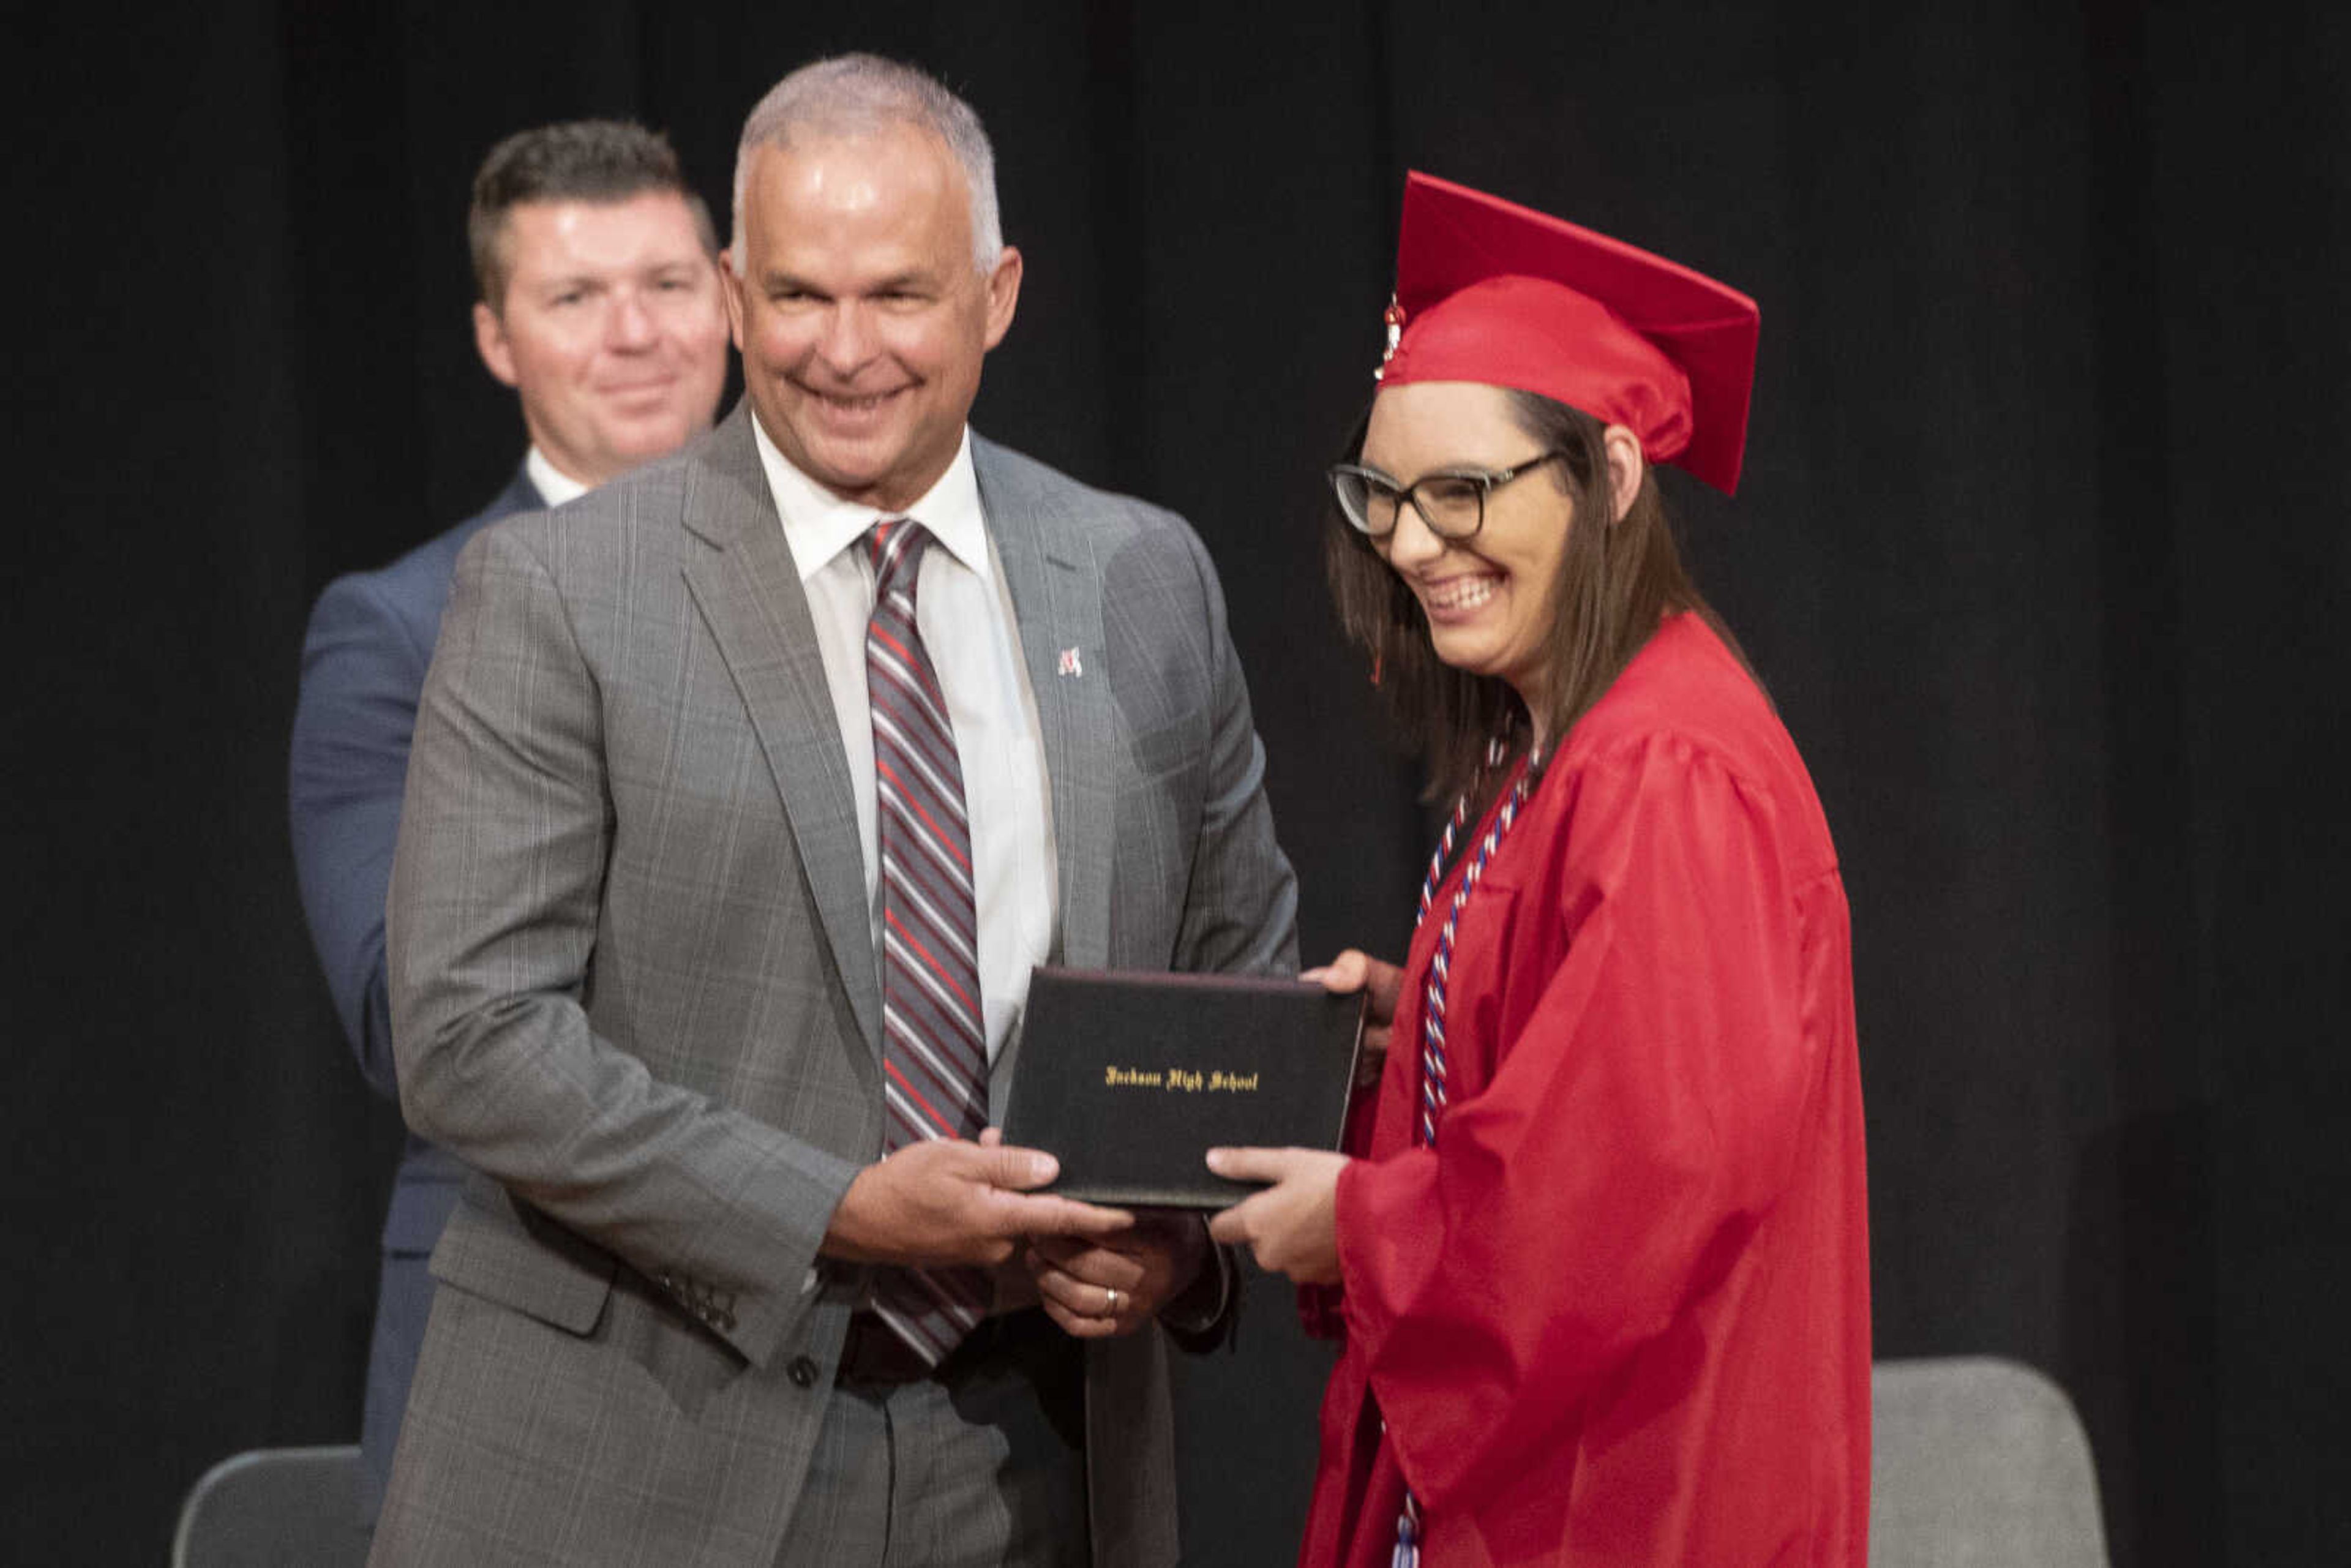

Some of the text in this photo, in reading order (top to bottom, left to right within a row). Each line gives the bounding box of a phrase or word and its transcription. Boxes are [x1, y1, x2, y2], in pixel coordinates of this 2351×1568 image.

[1106, 1066, 1258, 1093] Jackson High School
